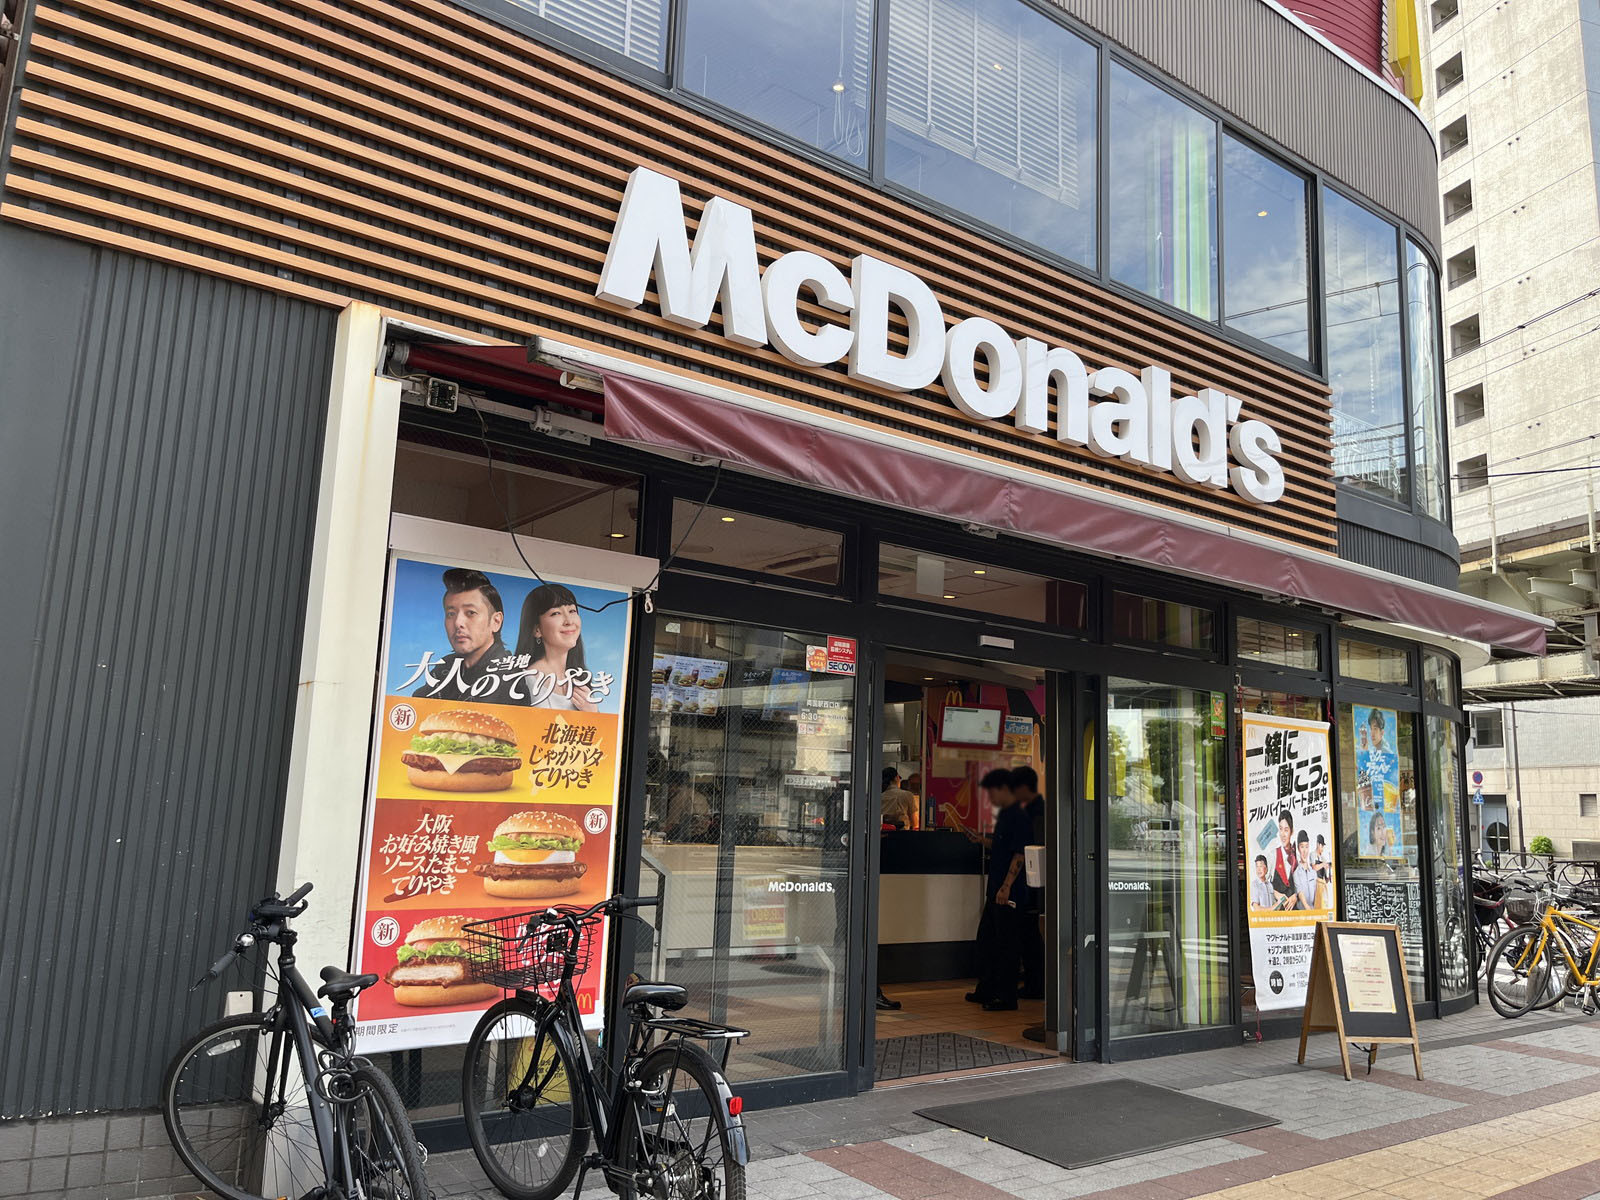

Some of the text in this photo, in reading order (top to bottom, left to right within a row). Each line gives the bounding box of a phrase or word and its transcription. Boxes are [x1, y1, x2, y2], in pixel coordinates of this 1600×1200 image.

[595, 166, 1285, 505] McDonald's
[486, 653, 532, 673] ご当地
[828, 661, 854, 672] SECOM
[395, 651, 615, 706] 大人のてりやき
[394, 710, 411, 726] 新
[541, 722, 597, 746] 北海道
[529, 744, 604, 767] じゃがバタ
[1246, 730, 1299, 768] 一緒に
[532, 766, 594, 789] てりやき
[1277, 755, 1329, 800] 働こう。
[413, 813, 454, 834] 大阪
[587, 812, 604, 829] 新
[379, 834, 480, 855] お好み焼き風
[382, 855, 471, 875] ソースたまご
[391, 875, 457, 896] てりやき
[767, 881, 834, 893] McDonald's
[376, 922, 395, 940] 新
[355, 1023, 399, 1037] 期間限定
